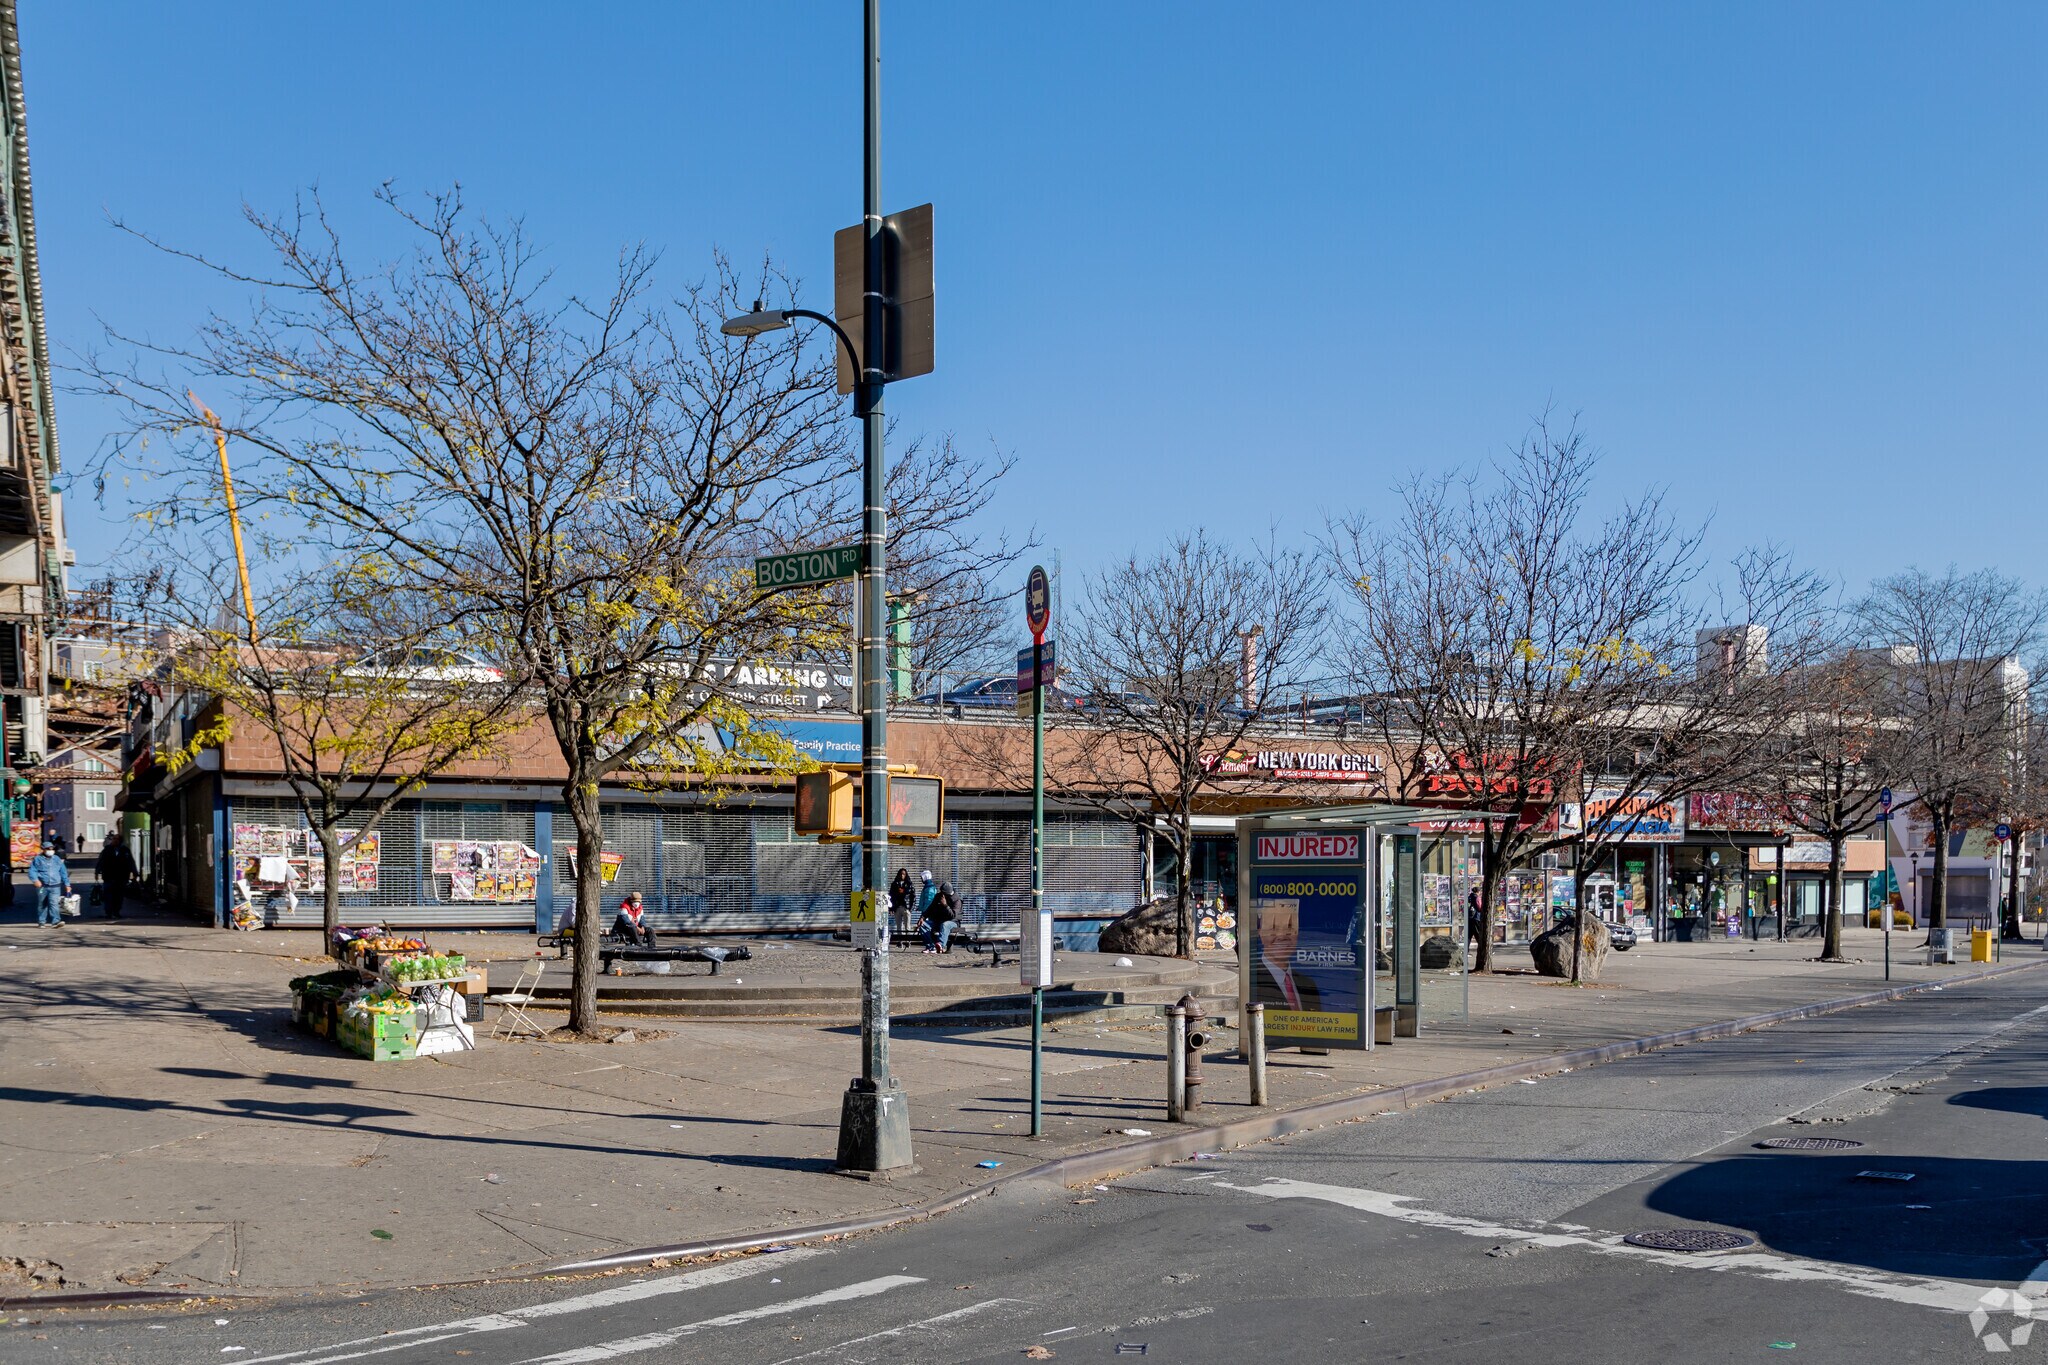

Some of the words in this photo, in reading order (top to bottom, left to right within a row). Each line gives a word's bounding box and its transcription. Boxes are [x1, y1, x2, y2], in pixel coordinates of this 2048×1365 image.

[758, 552, 838, 585] BOSTON
[841, 549, 857, 563] RD
[724, 664, 828, 689] PARKING
[793, 739, 824, 751] Family
[825, 742, 861, 752] Practice
[1258, 751, 1294, 769] NEW
[1296, 753, 1337, 771] YORK
[1342, 755, 1383, 772] GRILL
[1585, 797, 1679, 823] PHARMACY
[1258, 836, 1358, 857] INJURED?
[1296, 949, 1356, 962] BARNES
[1263, 1023, 1289, 1031] ARGEST
